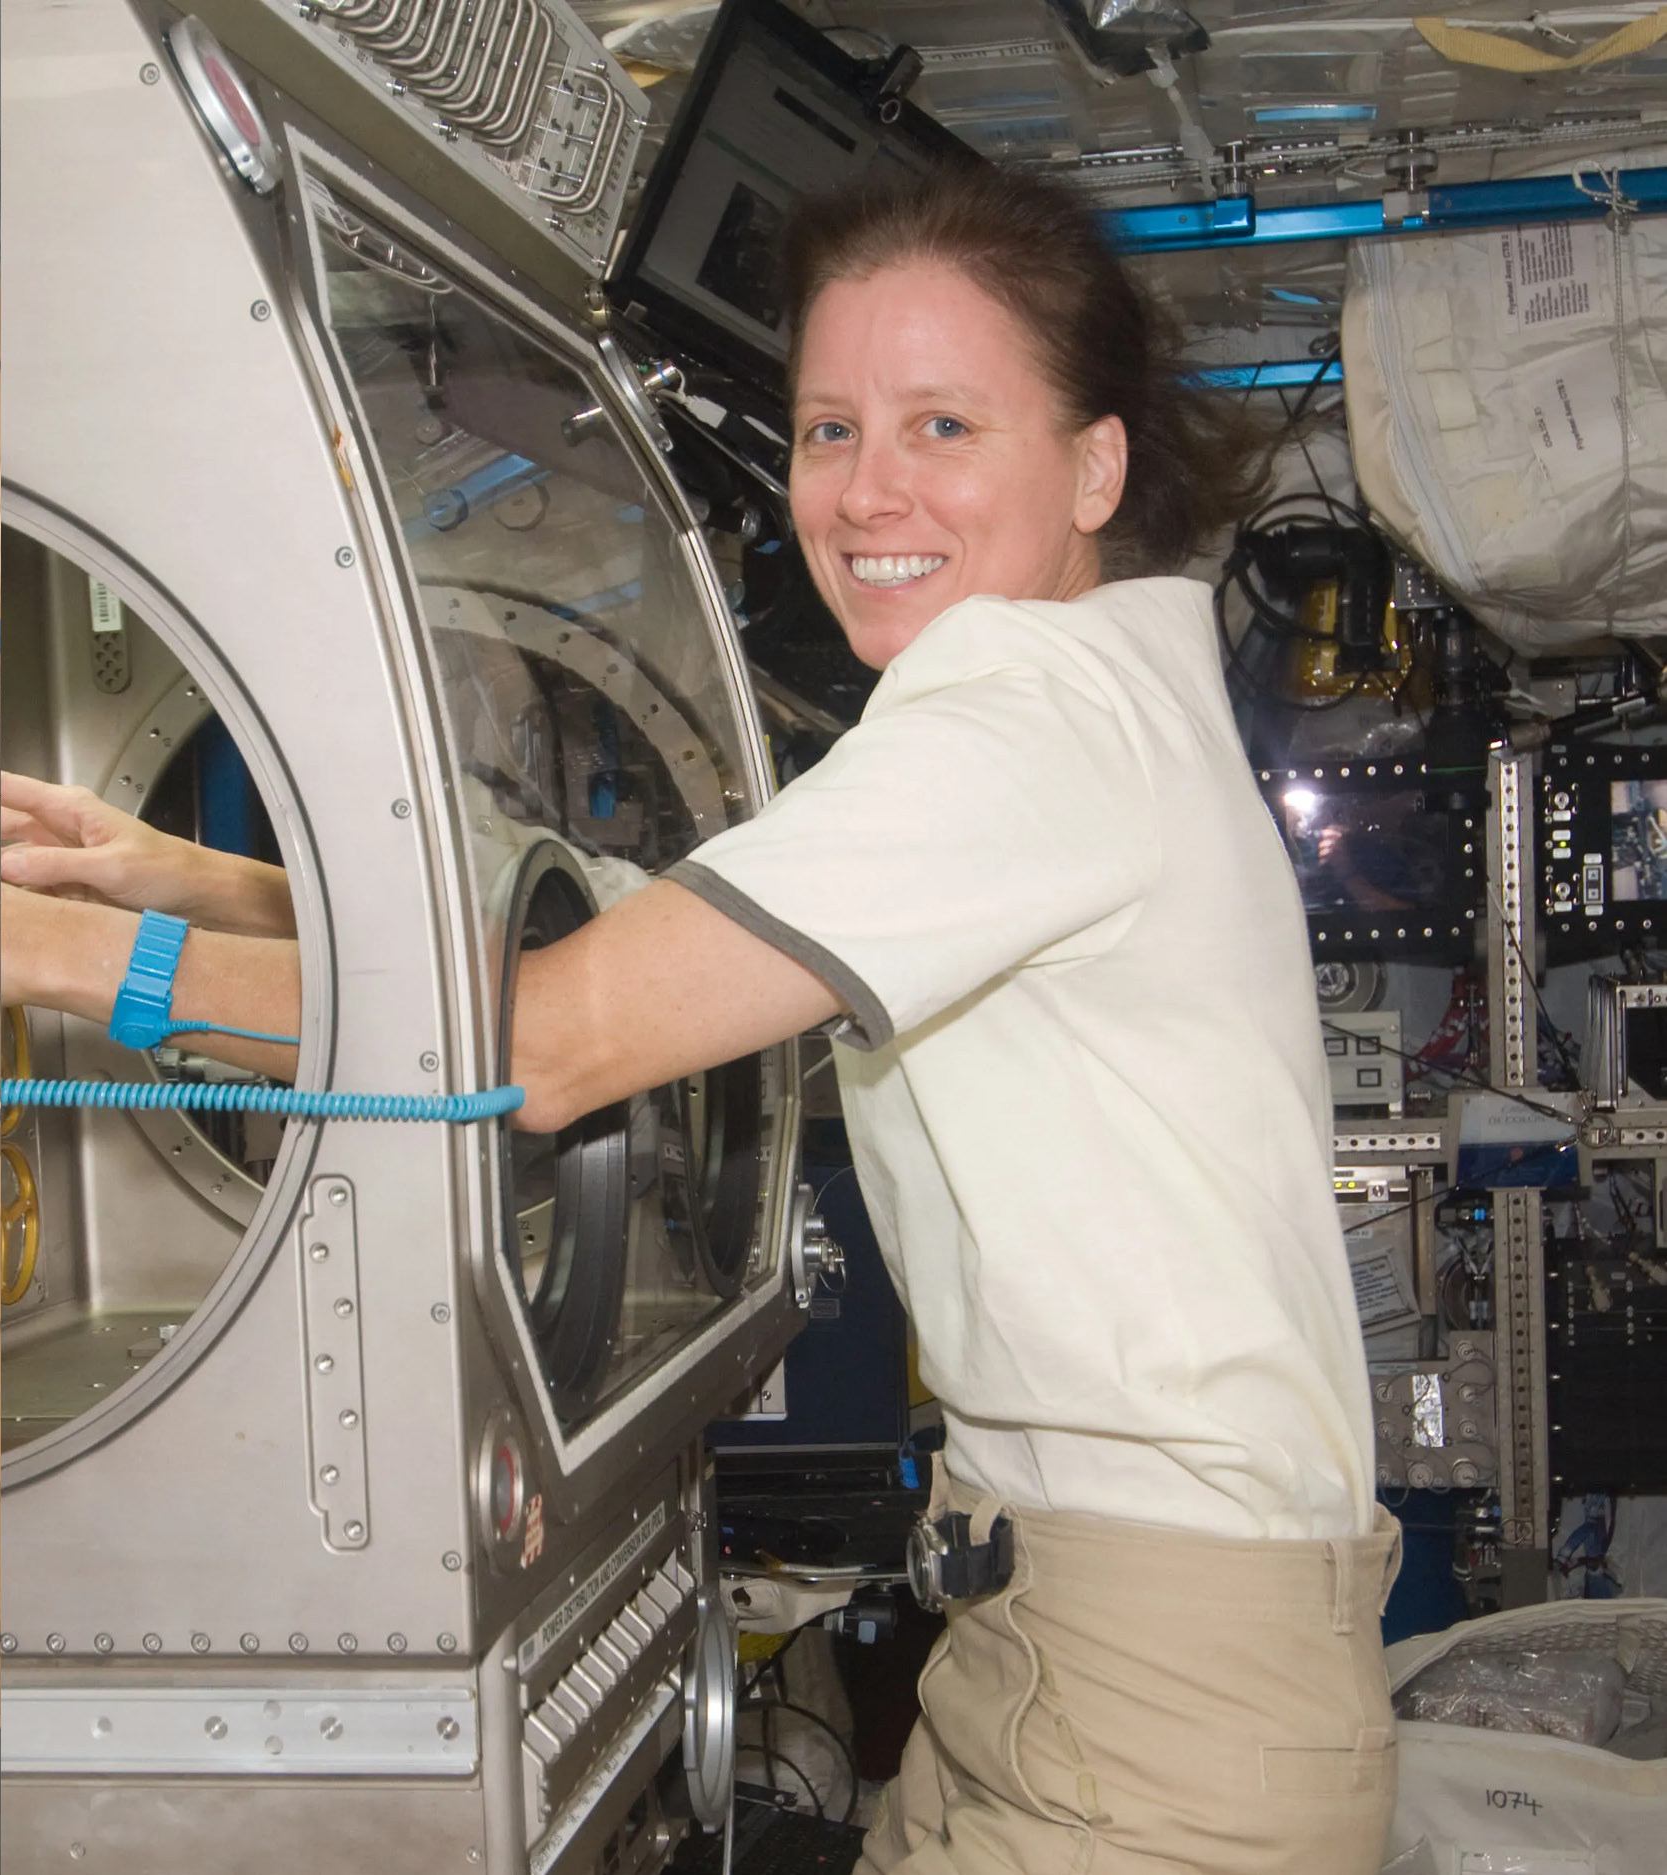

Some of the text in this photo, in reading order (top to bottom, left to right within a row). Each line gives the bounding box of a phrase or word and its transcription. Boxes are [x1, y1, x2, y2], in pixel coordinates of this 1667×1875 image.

[542, 1609, 564, 1647] POWER
[563, 1576, 600, 1623] DISTRIBUTION
[599, 1564, 612, 1588] AND
[610, 1533, 642, 1577] CONVERSION
[1485, 1788, 1544, 1817] 1074
